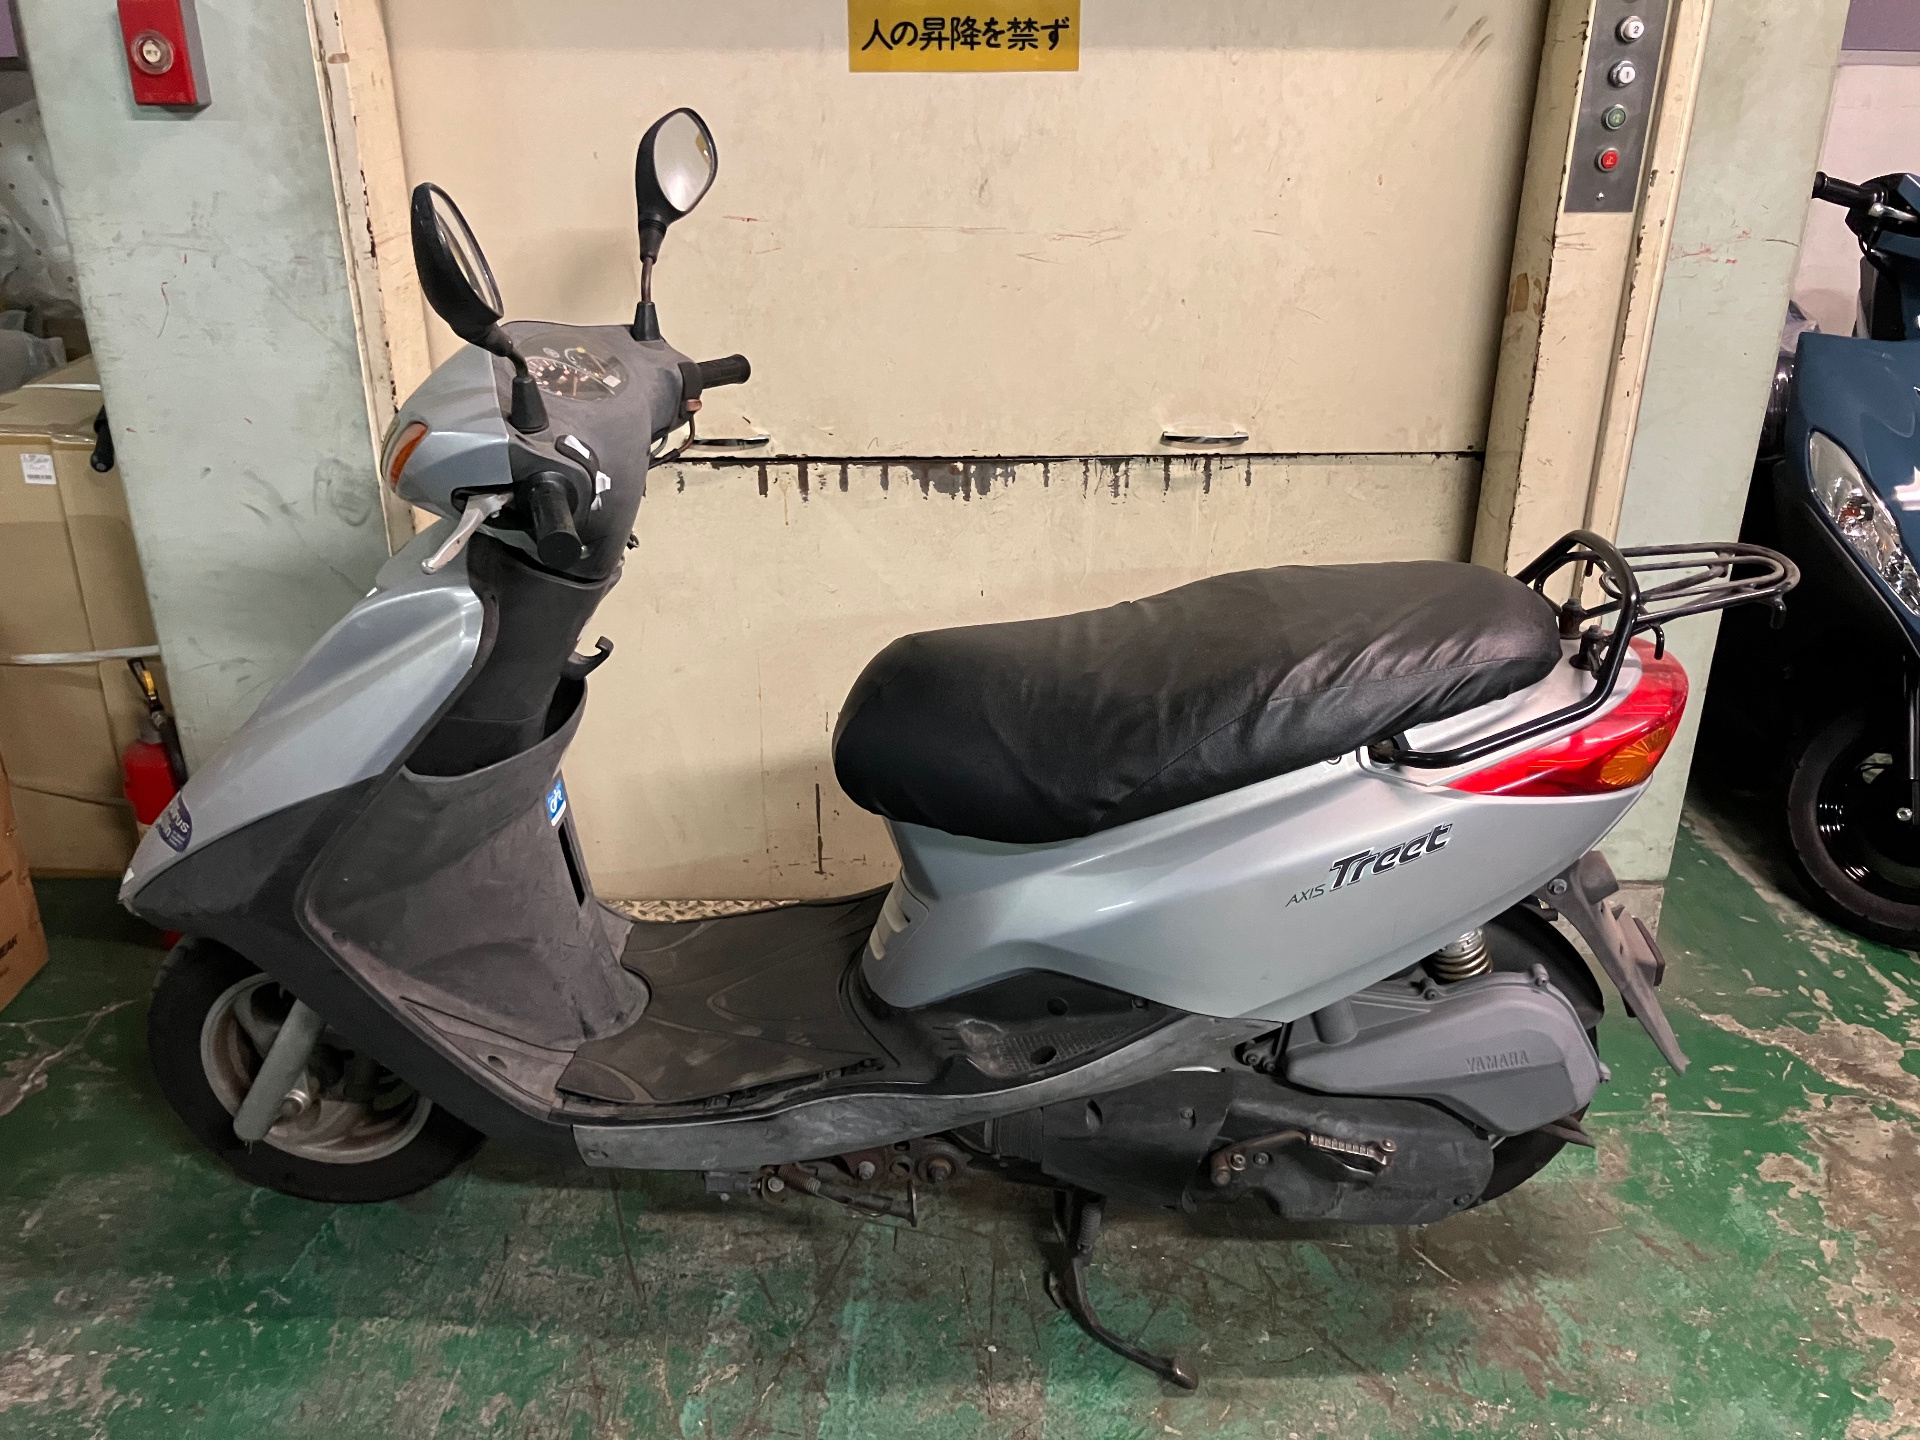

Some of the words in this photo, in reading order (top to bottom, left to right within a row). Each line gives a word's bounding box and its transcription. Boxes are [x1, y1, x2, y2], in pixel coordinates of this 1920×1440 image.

[861, 16, 1070, 51] 人の昇降を禁ず
[1285, 884, 1326, 907] AXIS
[1329, 823, 1453, 892] Treet
[1466, 1050, 1530, 1072] YAMAHA
